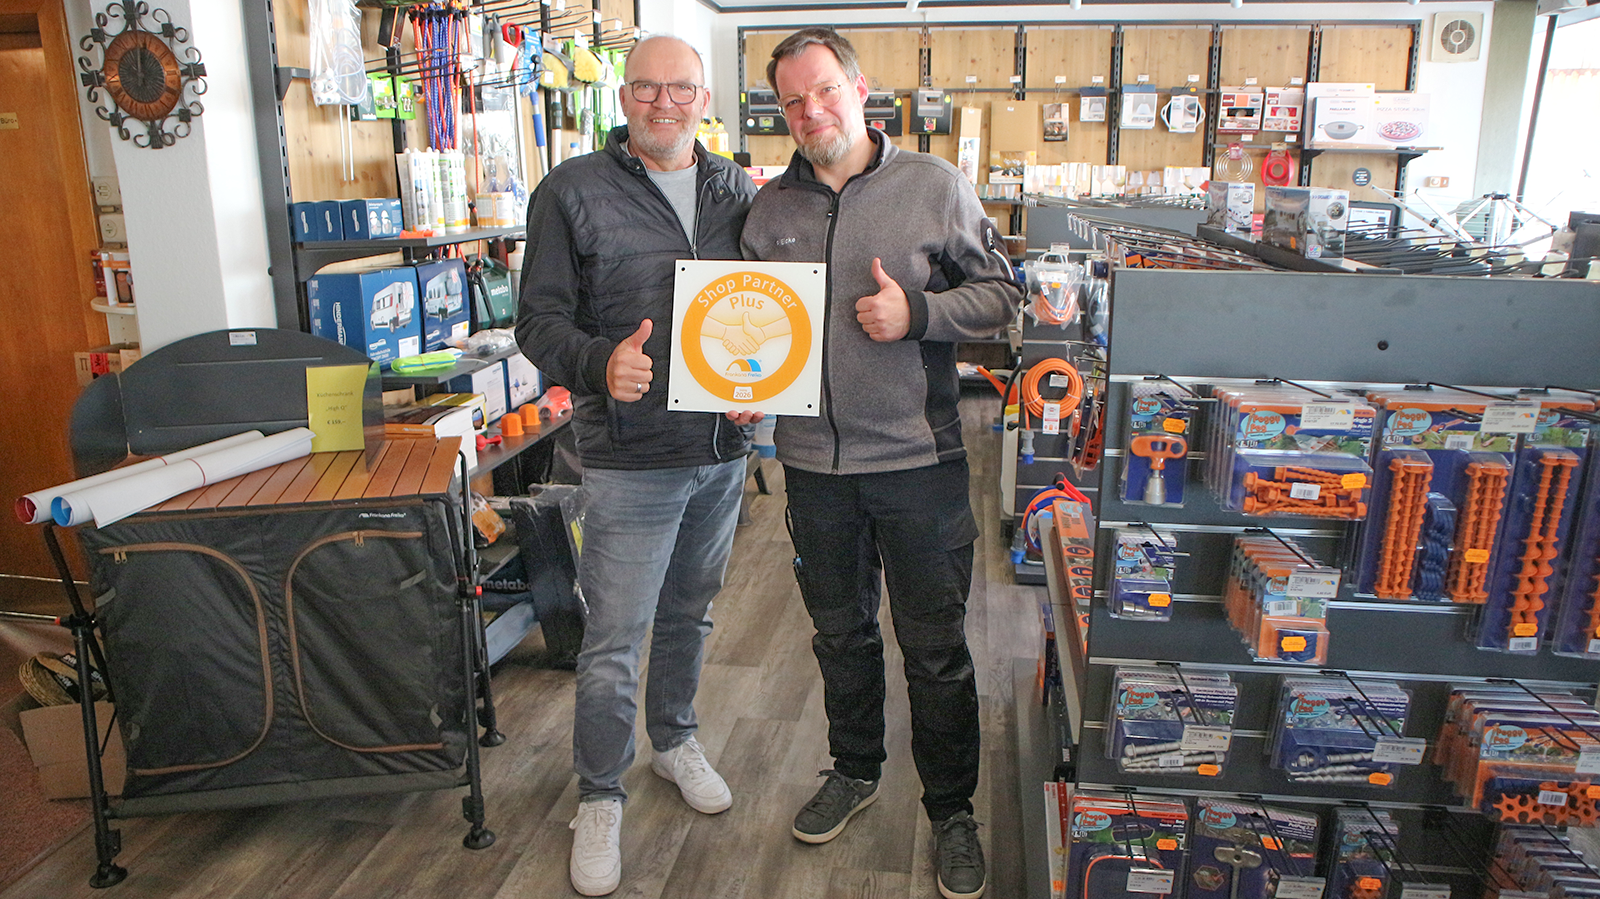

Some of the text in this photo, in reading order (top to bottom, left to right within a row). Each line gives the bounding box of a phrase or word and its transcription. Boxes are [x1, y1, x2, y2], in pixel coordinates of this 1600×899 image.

[697, 274, 798, 310] Shop Partner
[729, 294, 764, 310] Plus
[1253, 414, 1281, 424] Peggy
[1400, 411, 1427, 422] Peggy
[1250, 422, 1267, 433] Peg
[1397, 420, 1414, 430] Peg
[1131, 690, 1155, 699] Peggy
[1128, 697, 1144, 705] Peg
[1302, 698, 1326, 707] Peggy
[1496, 729, 1524, 738] Peggy
[1084, 813, 1108, 821] Peggy
[1208, 808, 1232, 819] Peggy
[1206, 815, 1221, 823] Peg
